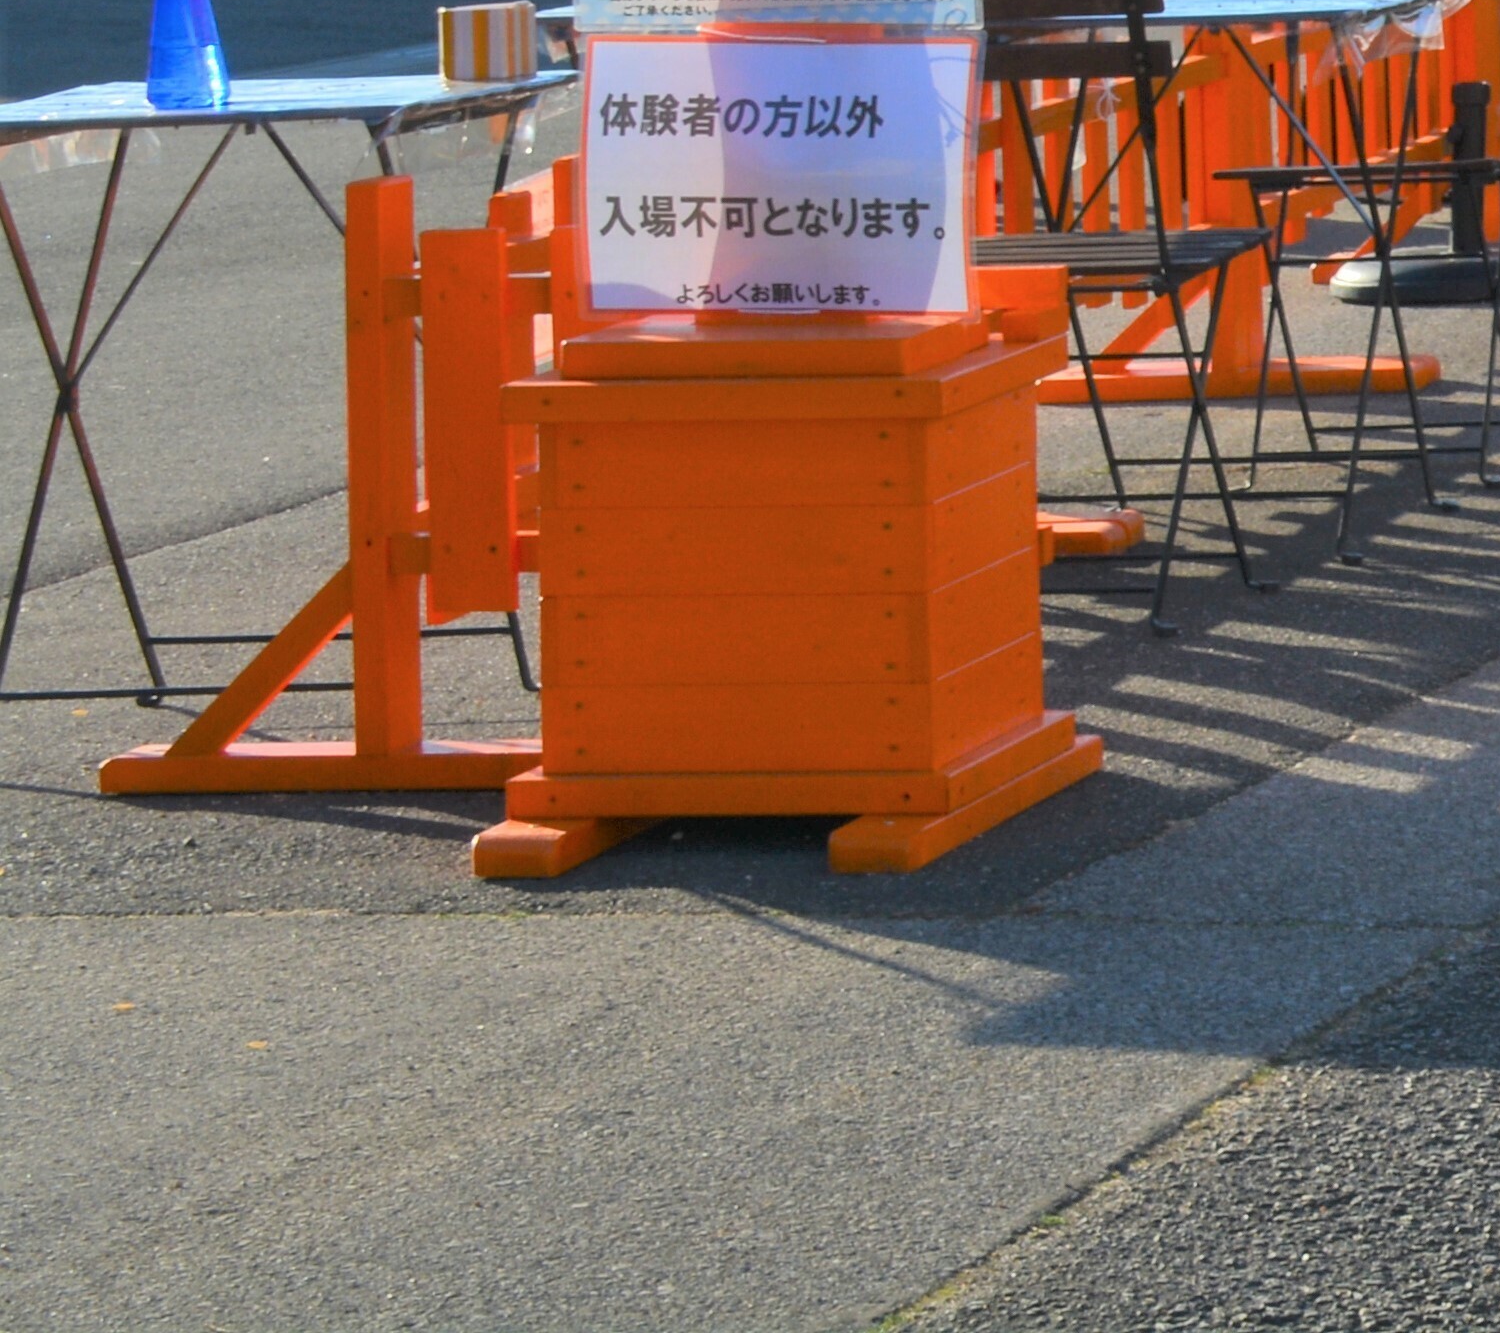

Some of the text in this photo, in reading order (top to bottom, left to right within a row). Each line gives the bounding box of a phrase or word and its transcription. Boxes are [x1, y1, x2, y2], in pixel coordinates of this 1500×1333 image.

[623, 5, 713, 17] ご了承ください。
[600, 92, 884, 139] 体験者の方以外
[599, 195, 946, 240] 入場不可となります。
[676, 283, 881, 307] よろしくお願いします。
